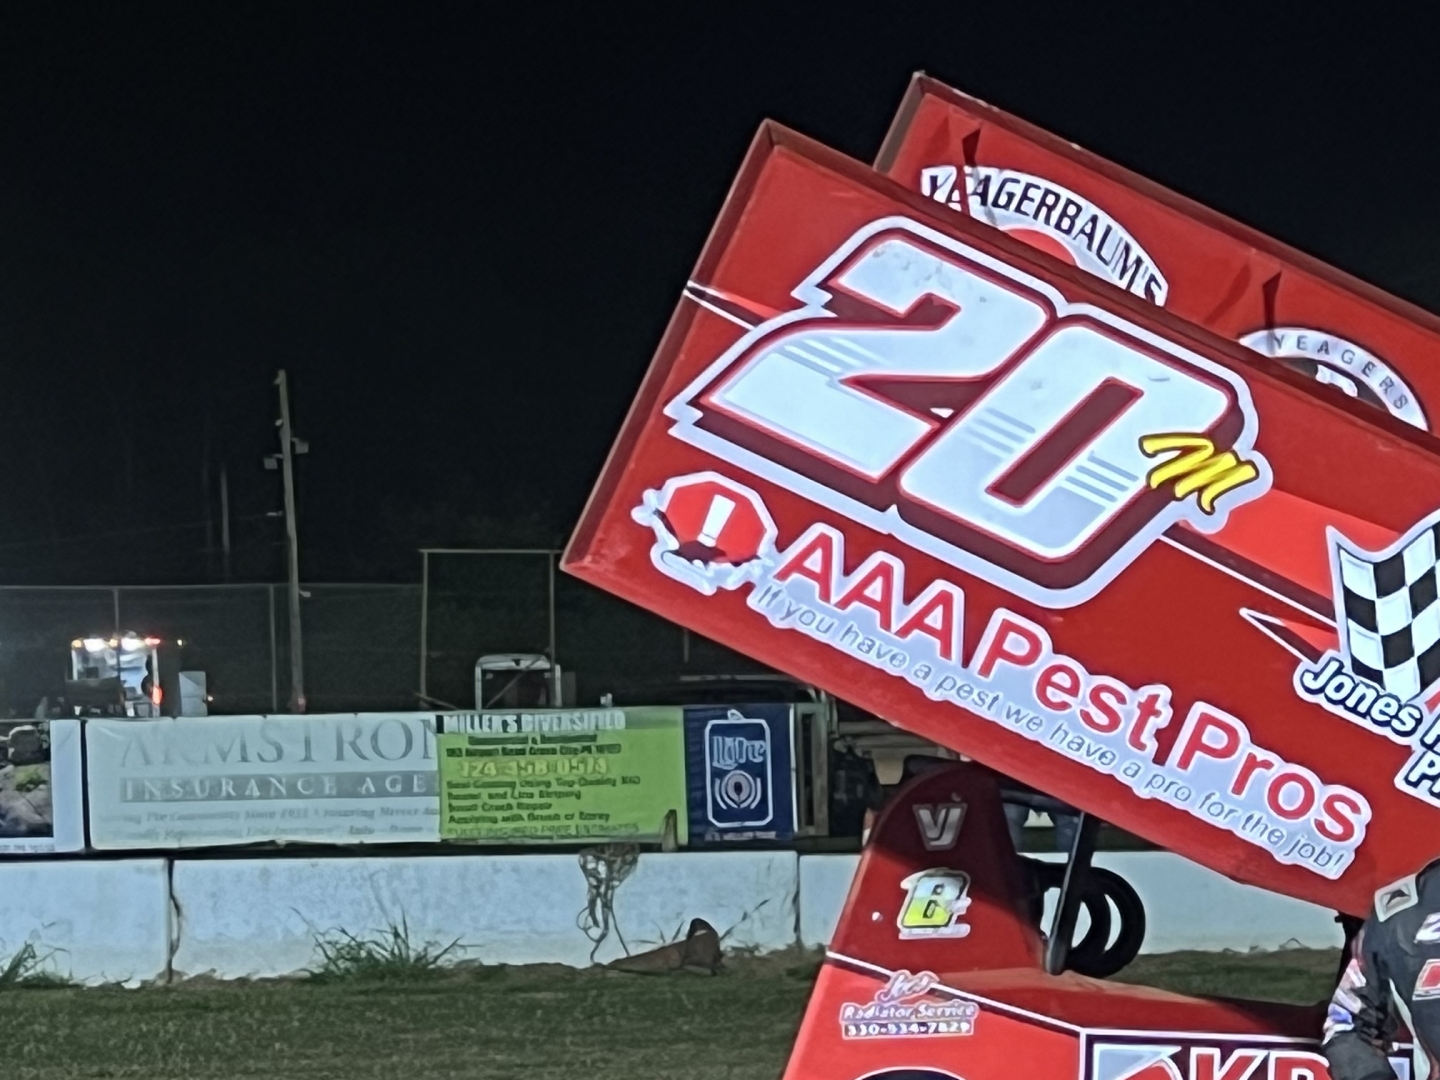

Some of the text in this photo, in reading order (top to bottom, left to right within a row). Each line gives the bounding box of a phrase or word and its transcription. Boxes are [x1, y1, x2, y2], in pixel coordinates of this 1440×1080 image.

[685, 228, 1240, 575] 20
[1273, 332, 1409, 410] YEAGERS
[443, 713, 518, 734] MILLER'S
[772, 530, 1363, 844] AAA Pest Pros
[1301, 657, 1424, 738] Jones
[120, 718, 435, 768] ARMSTRO
[780, 602, 836, 635] you
[839, 623, 908, 669] have
[913, 663, 932, 681] a
[934, 675, 1002, 711] pest
[1005, 703, 1044, 732] we
[1049, 722, 1117, 767] have
[1124, 760, 1141, 779] a
[1144, 772, 1192, 803] pro
[1198, 791, 1239, 822] for
[1240, 812, 1286, 848] the
[1284, 834, 1345, 868] job!
[125, 773, 338, 801] INSURANCE
[357, 772, 431, 794] AGE
[843, 1002, 976, 1019] Radiator Service
